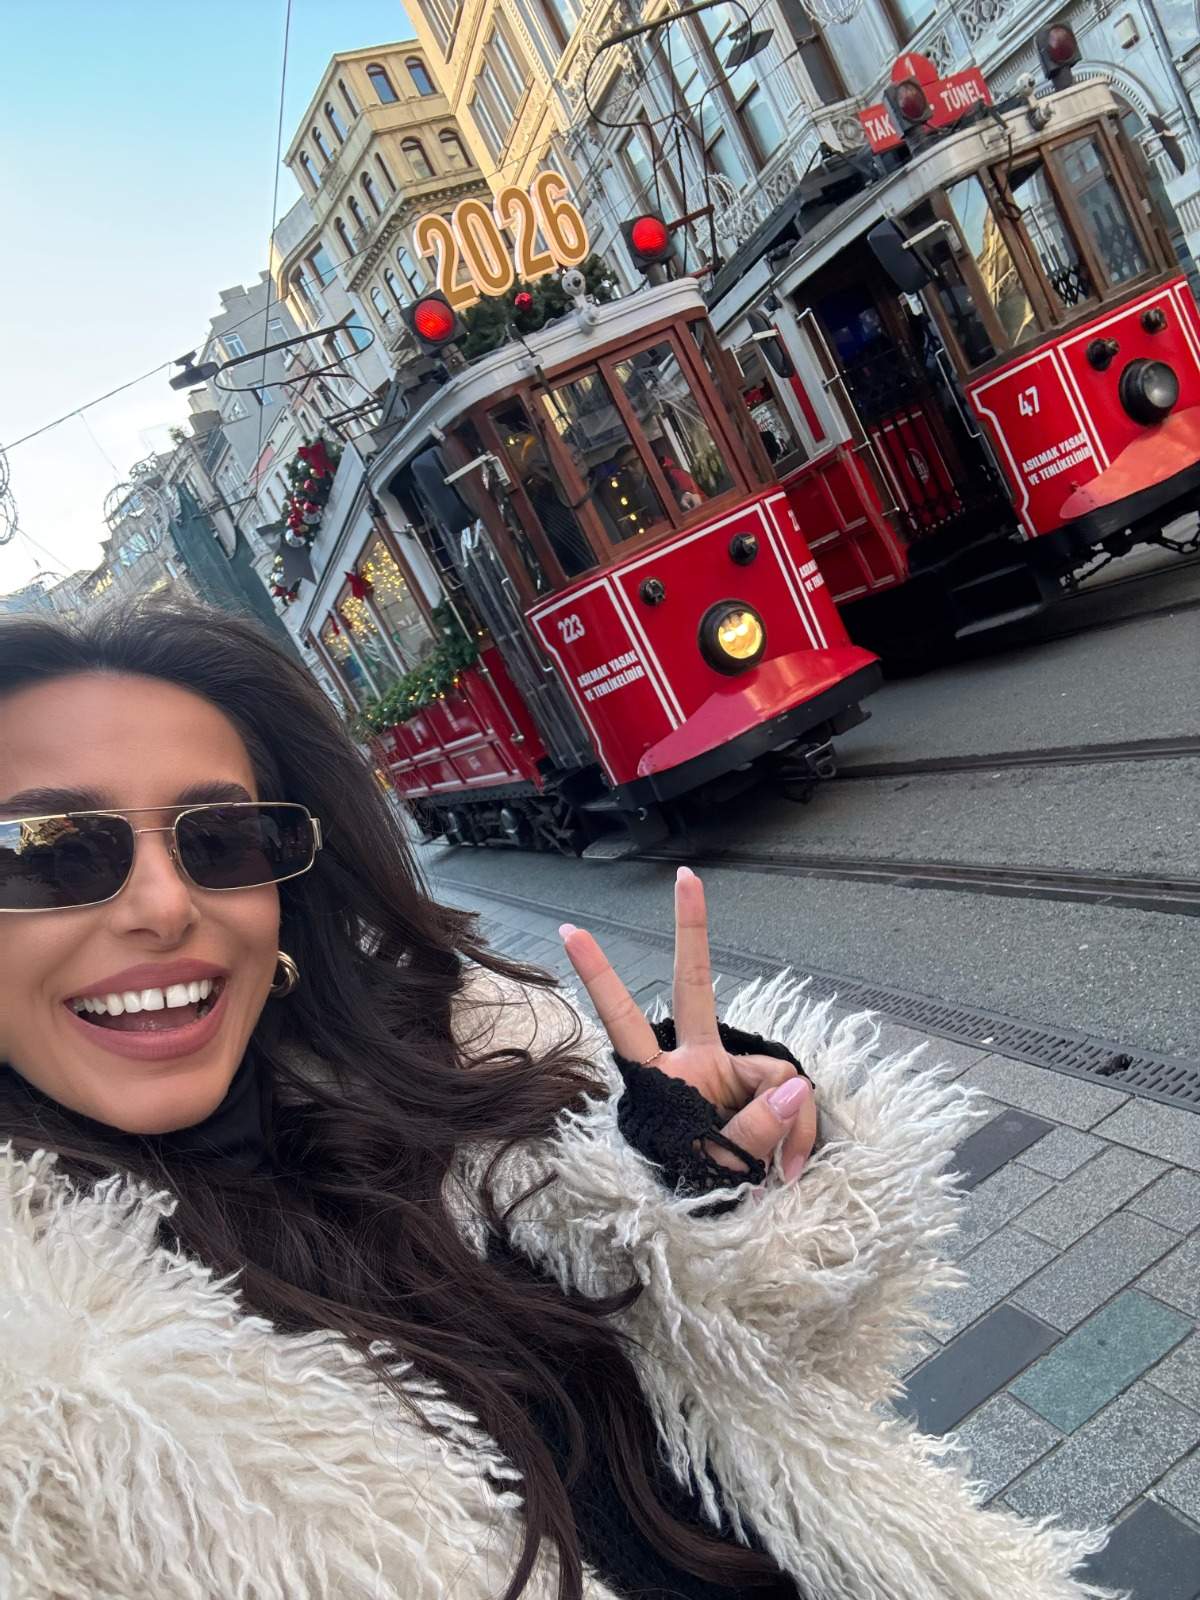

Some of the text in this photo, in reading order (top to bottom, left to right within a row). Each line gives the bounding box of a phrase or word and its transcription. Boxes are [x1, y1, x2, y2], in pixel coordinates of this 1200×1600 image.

[940, 80, 985, 112] TÜNEL
[413, 170, 589, 312] 2026
[1018, 386, 1040, 416] 47
[1022, 446, 1060, 473] ASILMAK
[1028, 473, 1040, 486] VE
[557, 613, 585, 644] 223
[608, 650, 638, 672] YASAK
